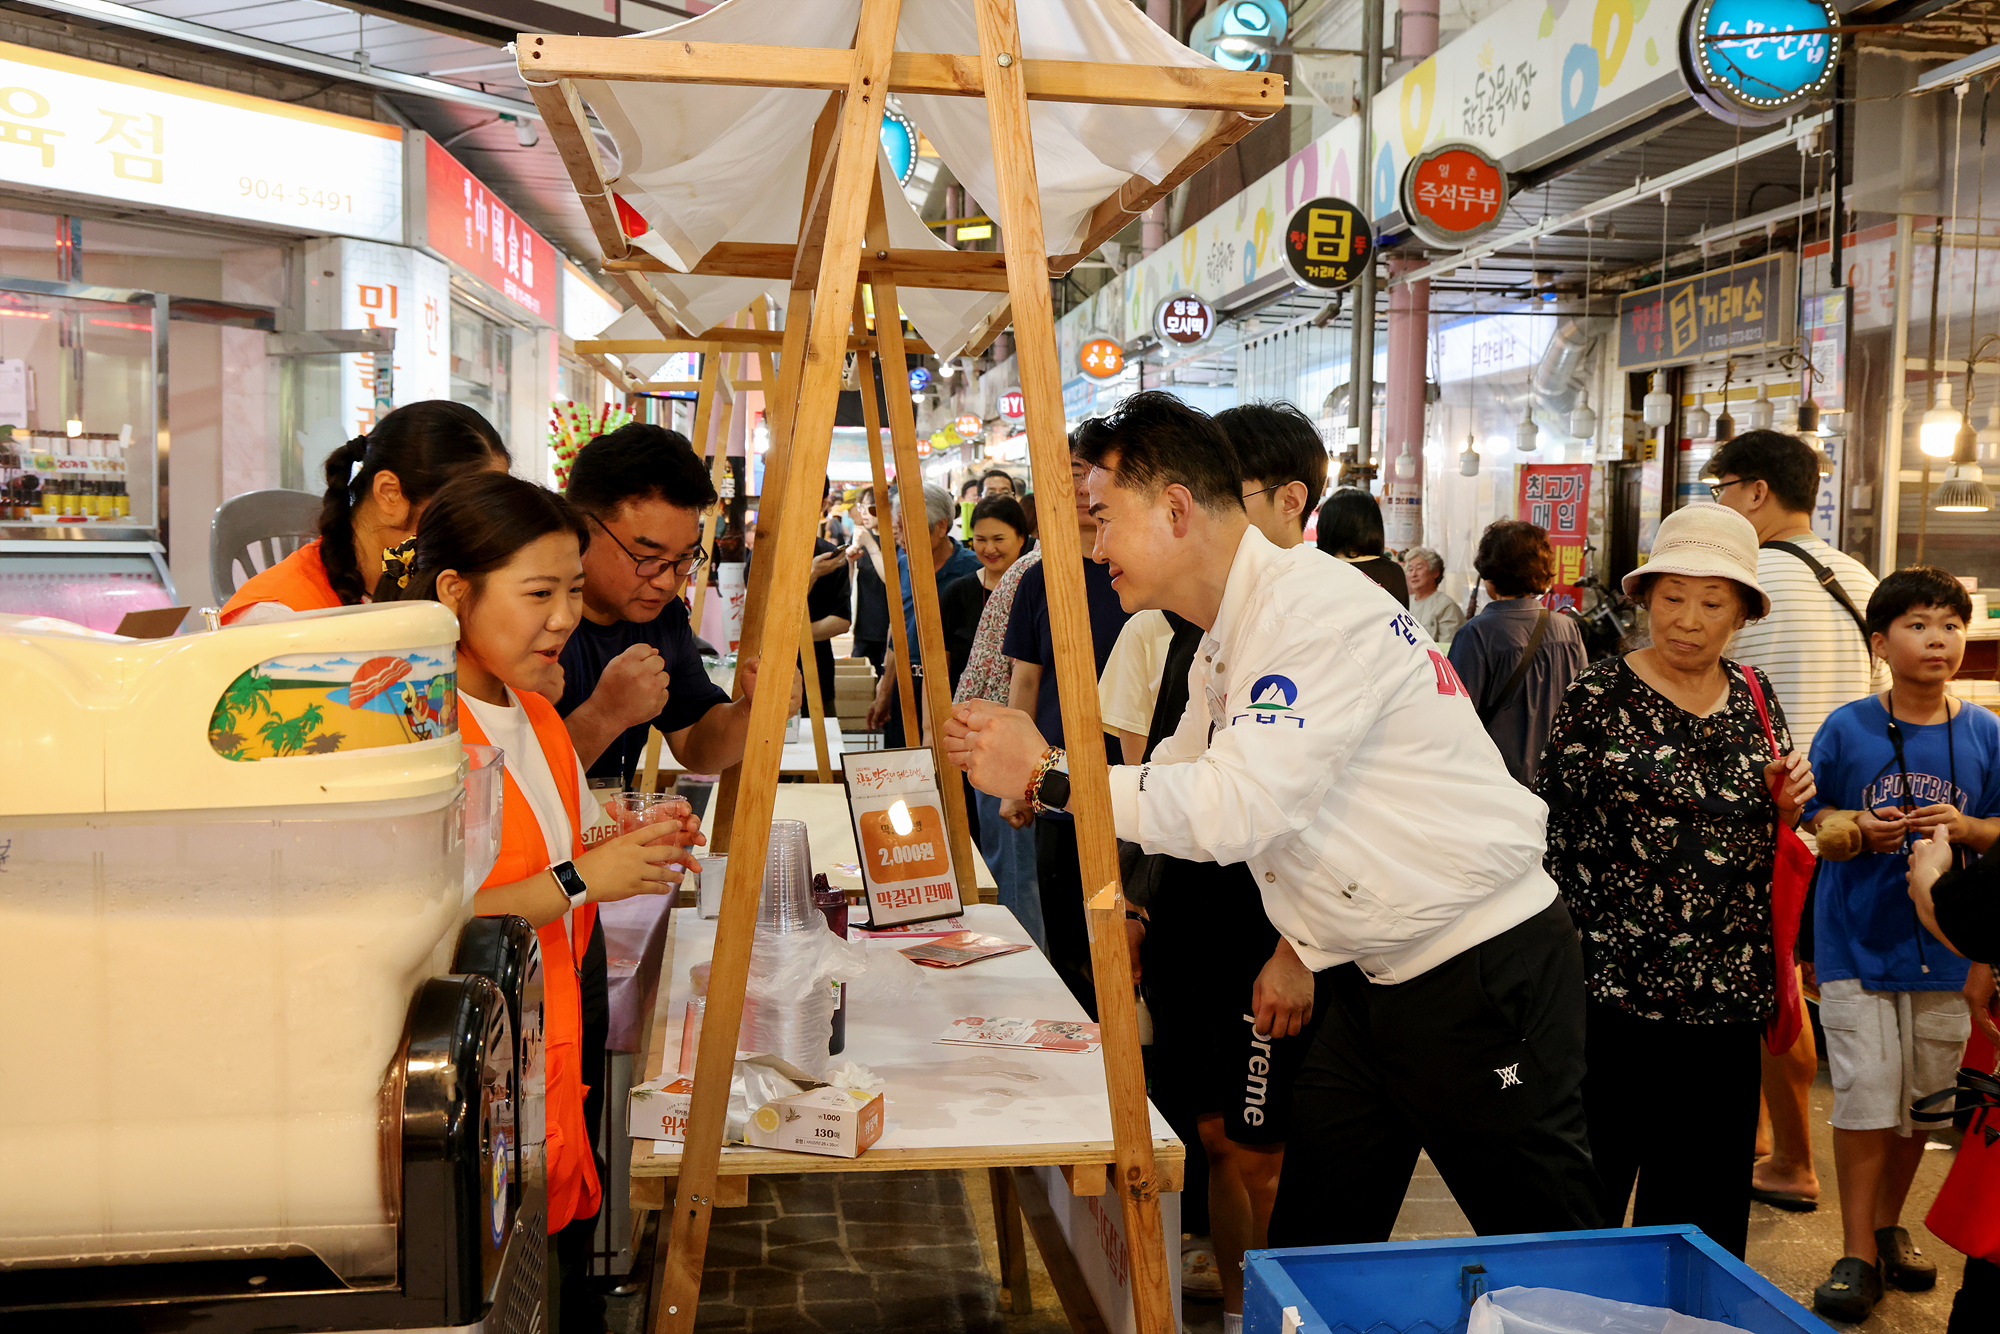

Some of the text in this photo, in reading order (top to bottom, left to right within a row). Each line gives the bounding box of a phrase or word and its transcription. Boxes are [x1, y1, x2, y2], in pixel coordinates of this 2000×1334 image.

[238, 176, 353, 213] 904-5491
[1418, 181, 1498, 213] 즉석두부
[1304, 265, 1348, 281] 거래소
[1699, 276, 1764, 327] 거래소
[1525, 473, 1585, 502] 최고가
[878, 841, 935, 867] 2,000원
[876, 882, 953, 909] 막걸리 판매
